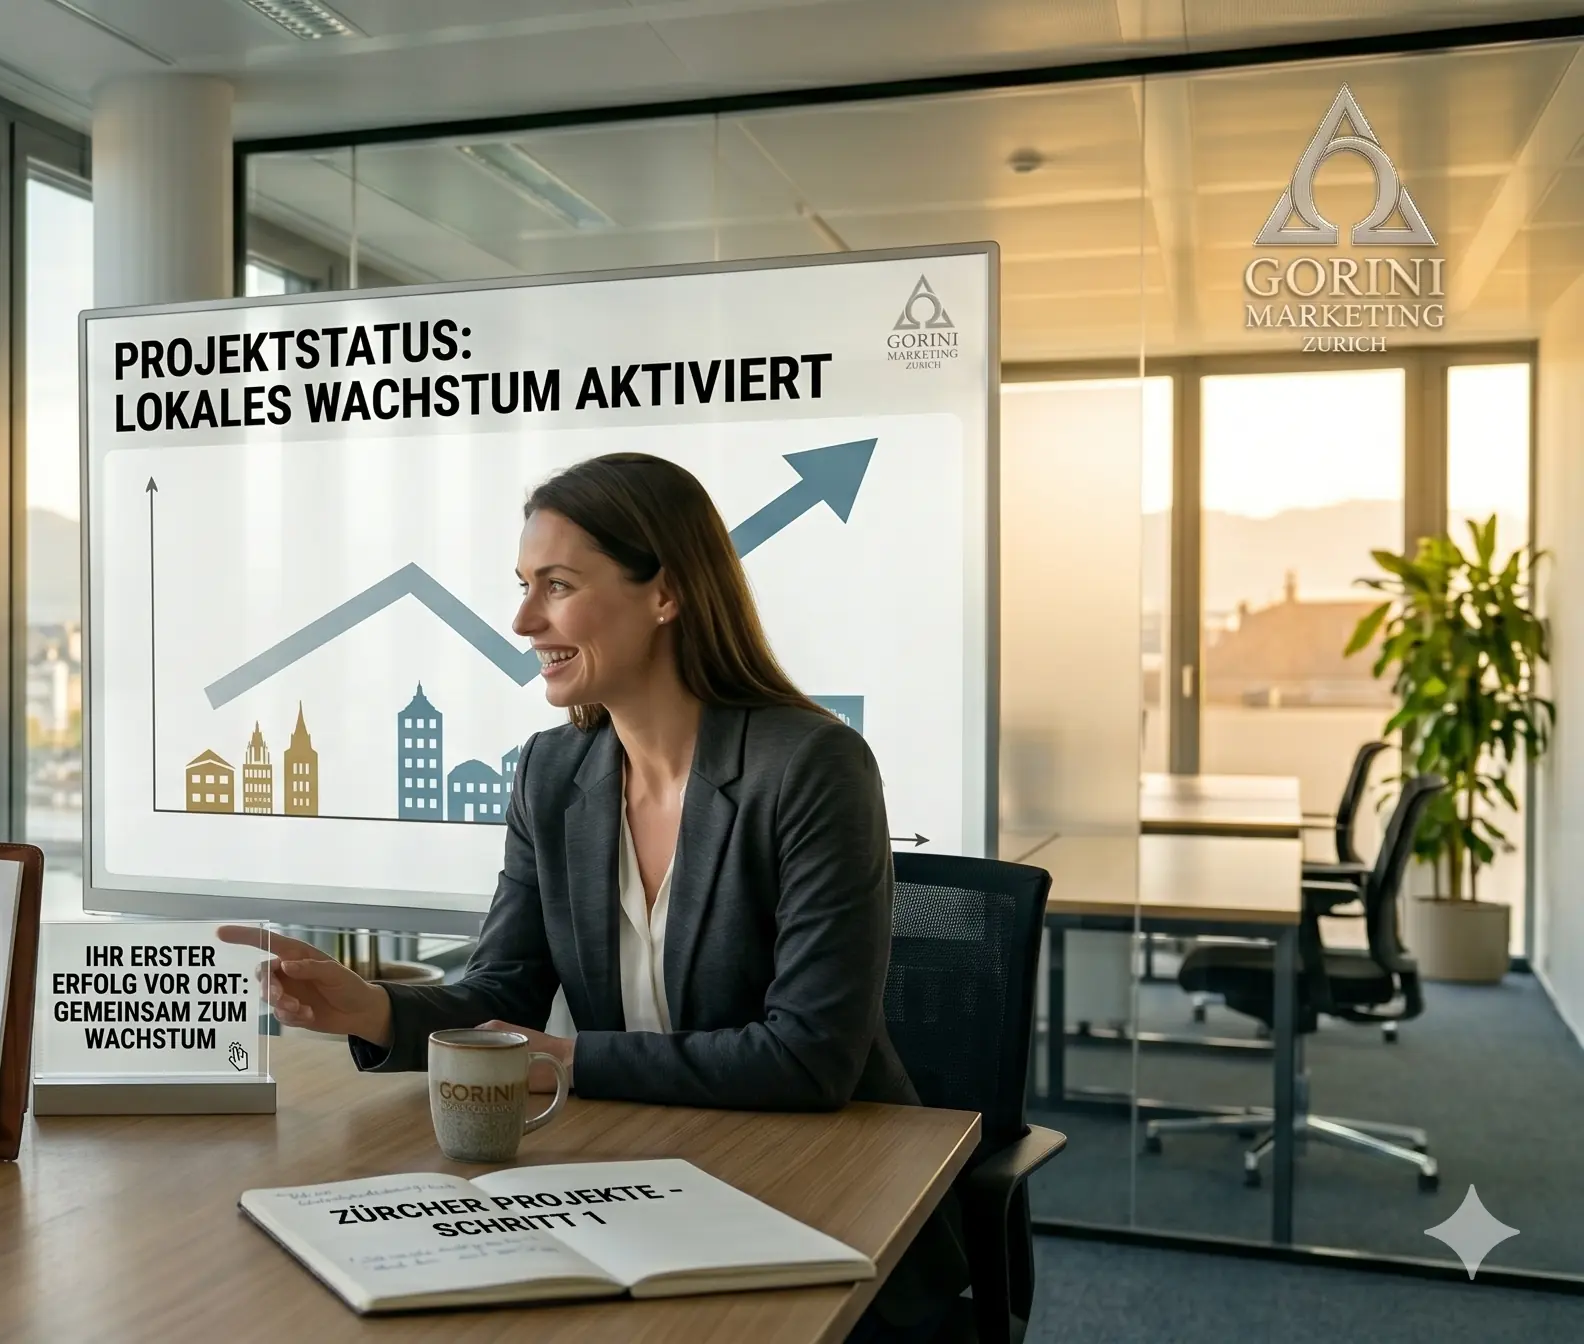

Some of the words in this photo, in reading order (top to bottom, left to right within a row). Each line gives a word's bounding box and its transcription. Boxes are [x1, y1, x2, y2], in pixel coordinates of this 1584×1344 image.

[115, 318, 472, 381] PROJEKTSTATUS:
[887, 332, 958, 348] GORINI
[887, 349, 958, 361] MARKETING
[115, 384, 292, 433] LOKALES
[304, 368, 560, 423] WACHSTUM
[575, 353, 833, 410] AKTIVIERT
[86, 945, 124, 967] IHR
[130, 945, 216, 967] ERSTER
[52, 973, 137, 995] ERFOLG
[143, 973, 190, 995] VOR
[197, 973, 249, 995] ORT:
[54, 1000, 191, 1023] GEMEINSAM
[197, 1001, 247, 1023] ZUM
[84, 1027, 216, 1050] WACHSTUM
[440, 1081, 514, 1103] GORINI
[329, 1198, 490, 1225] ZÜRCHER
[489, 1184, 665, 1211] PROJEKTE
[432, 1212, 577, 1237] SCHRITT
[582, 1210, 607, 1225] 1
